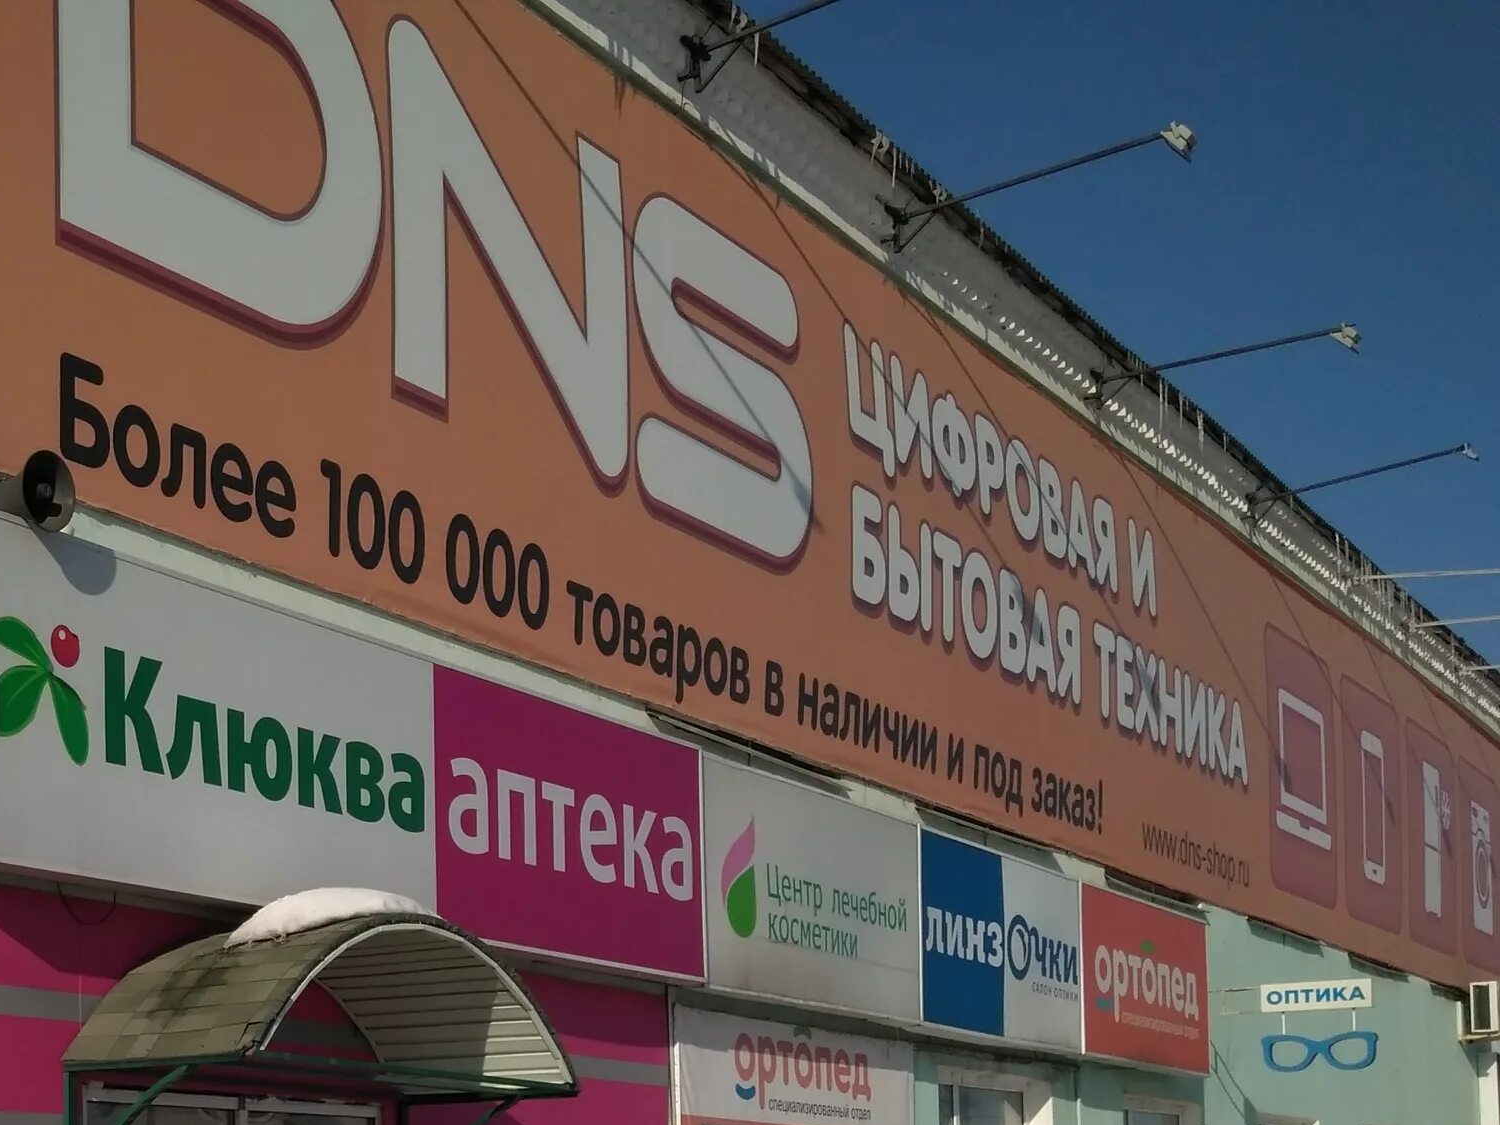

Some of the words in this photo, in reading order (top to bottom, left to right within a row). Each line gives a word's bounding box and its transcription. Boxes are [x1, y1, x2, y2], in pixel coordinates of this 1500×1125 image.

[56, 0, 814, 574] DNS
[844, 320, 1119, 594] ЦИФРОВАЯ
[1128, 518, 1157, 618] И
[59, 352, 296, 539] Более
[320, 459, 425, 584] 100
[446, 513, 550, 630] 000
[566, 578, 751, 705] товаров
[764, 660, 784, 717] в
[800, 673, 939, 774] наличии
[947, 735, 964, 779] и
[974, 744, 1023, 817] под
[1031, 763, 1104, 835] заказ!
[851, 481, 1081, 705] БЫТОВАЯ
[1094, 620, 1249, 787] ТЕХНИКА
[103, 646, 425, 833] Клюква
[448, 756, 694, 903] аптека
[1142, 822, 1249, 890] www.dns-shop.ru
[766, 863, 823, 917] Центр
[832, 888, 907, 932] лечебной
[769, 913, 858, 959] косметики
[1032, 981, 1052, 997] САЛОН
[1053, 987, 1078, 1002] ОПТИКИ
[1095, 944, 1199, 1022] ортопед
[1267, 986, 1366, 1005] ОПТИКА
[735, 1033, 871, 1110] ортопед
[768, 1099, 849, 1119] специализированный
[851, 1108, 871, 1121] отдел
